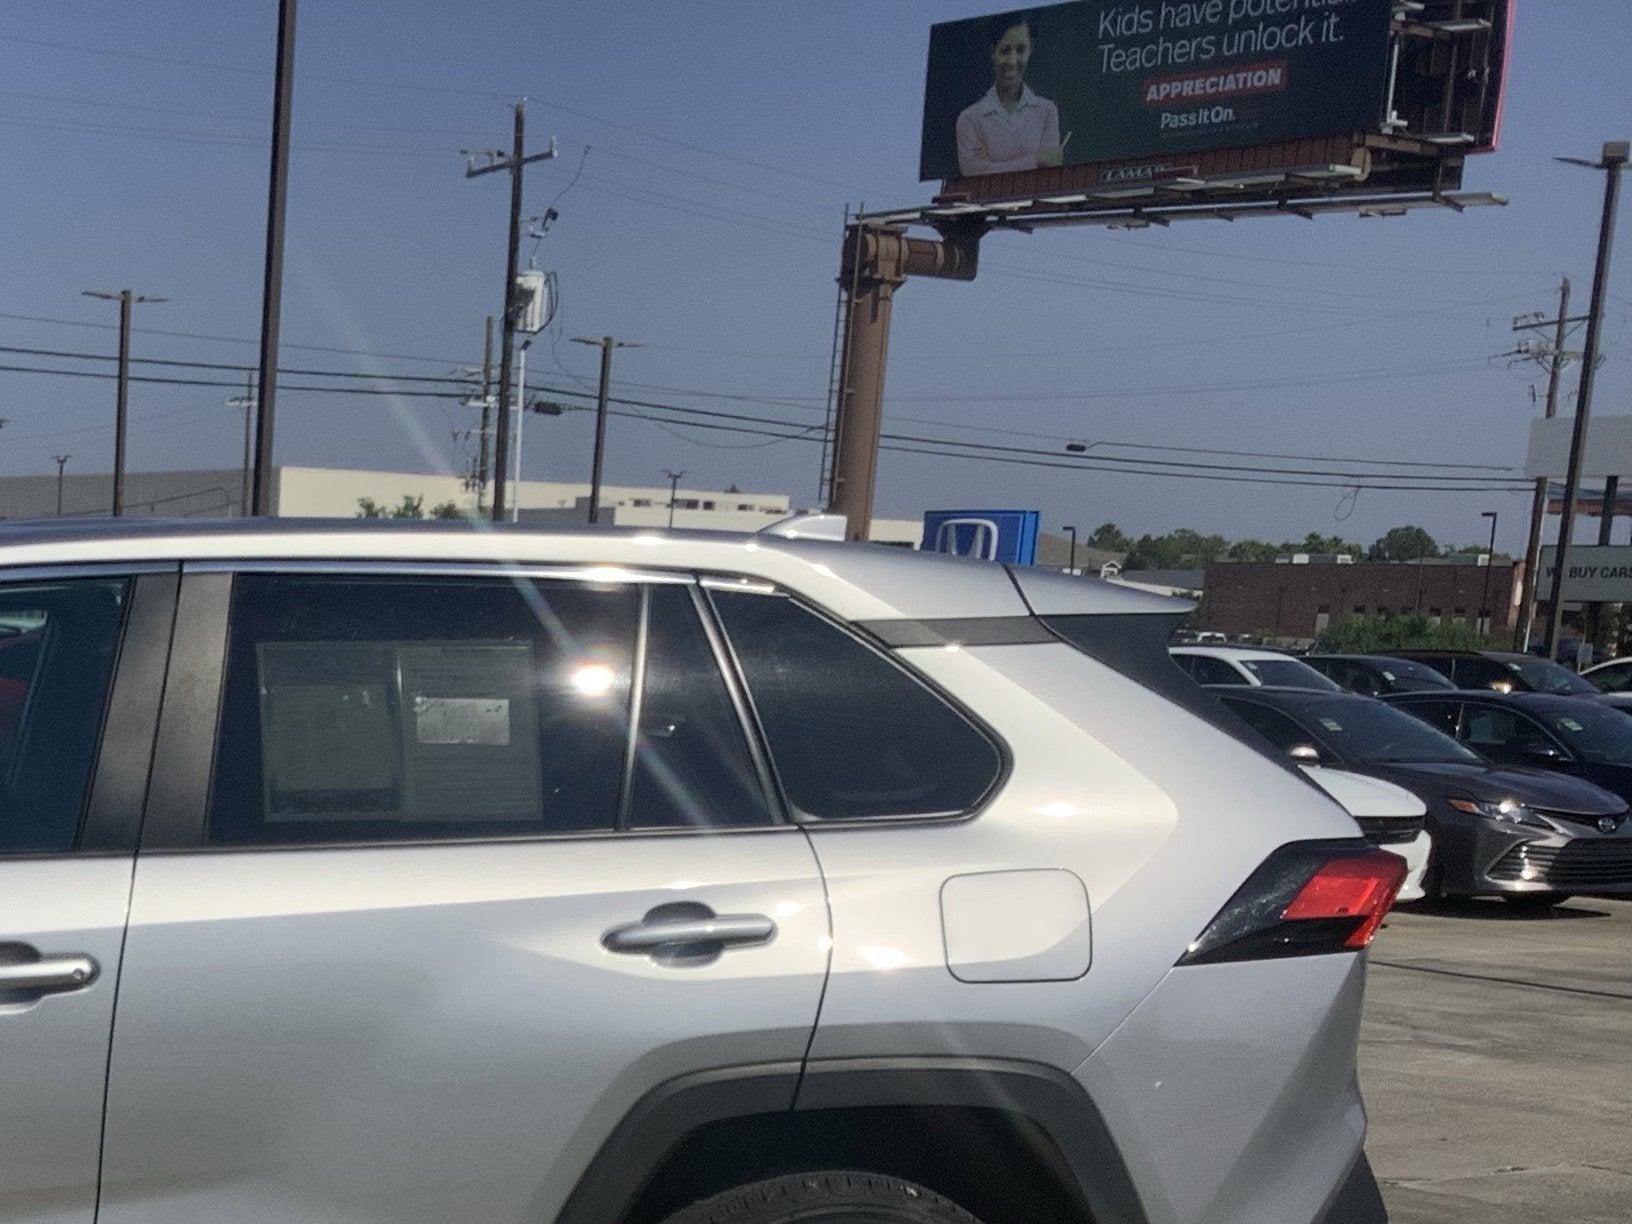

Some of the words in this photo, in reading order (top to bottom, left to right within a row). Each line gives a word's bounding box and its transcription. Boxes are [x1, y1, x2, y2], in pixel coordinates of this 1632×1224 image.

[1099, 9, 1153, 39] Kids
[1159, 2, 1221, 30] have
[1098, 35, 1216, 73] Teachers
[1223, 15, 1316, 56] unlock
[1321, 12, 1345, 43] it.
[1146, 67, 1282, 102] APPRECIATION
[1569, 567, 1597, 578] BUY
